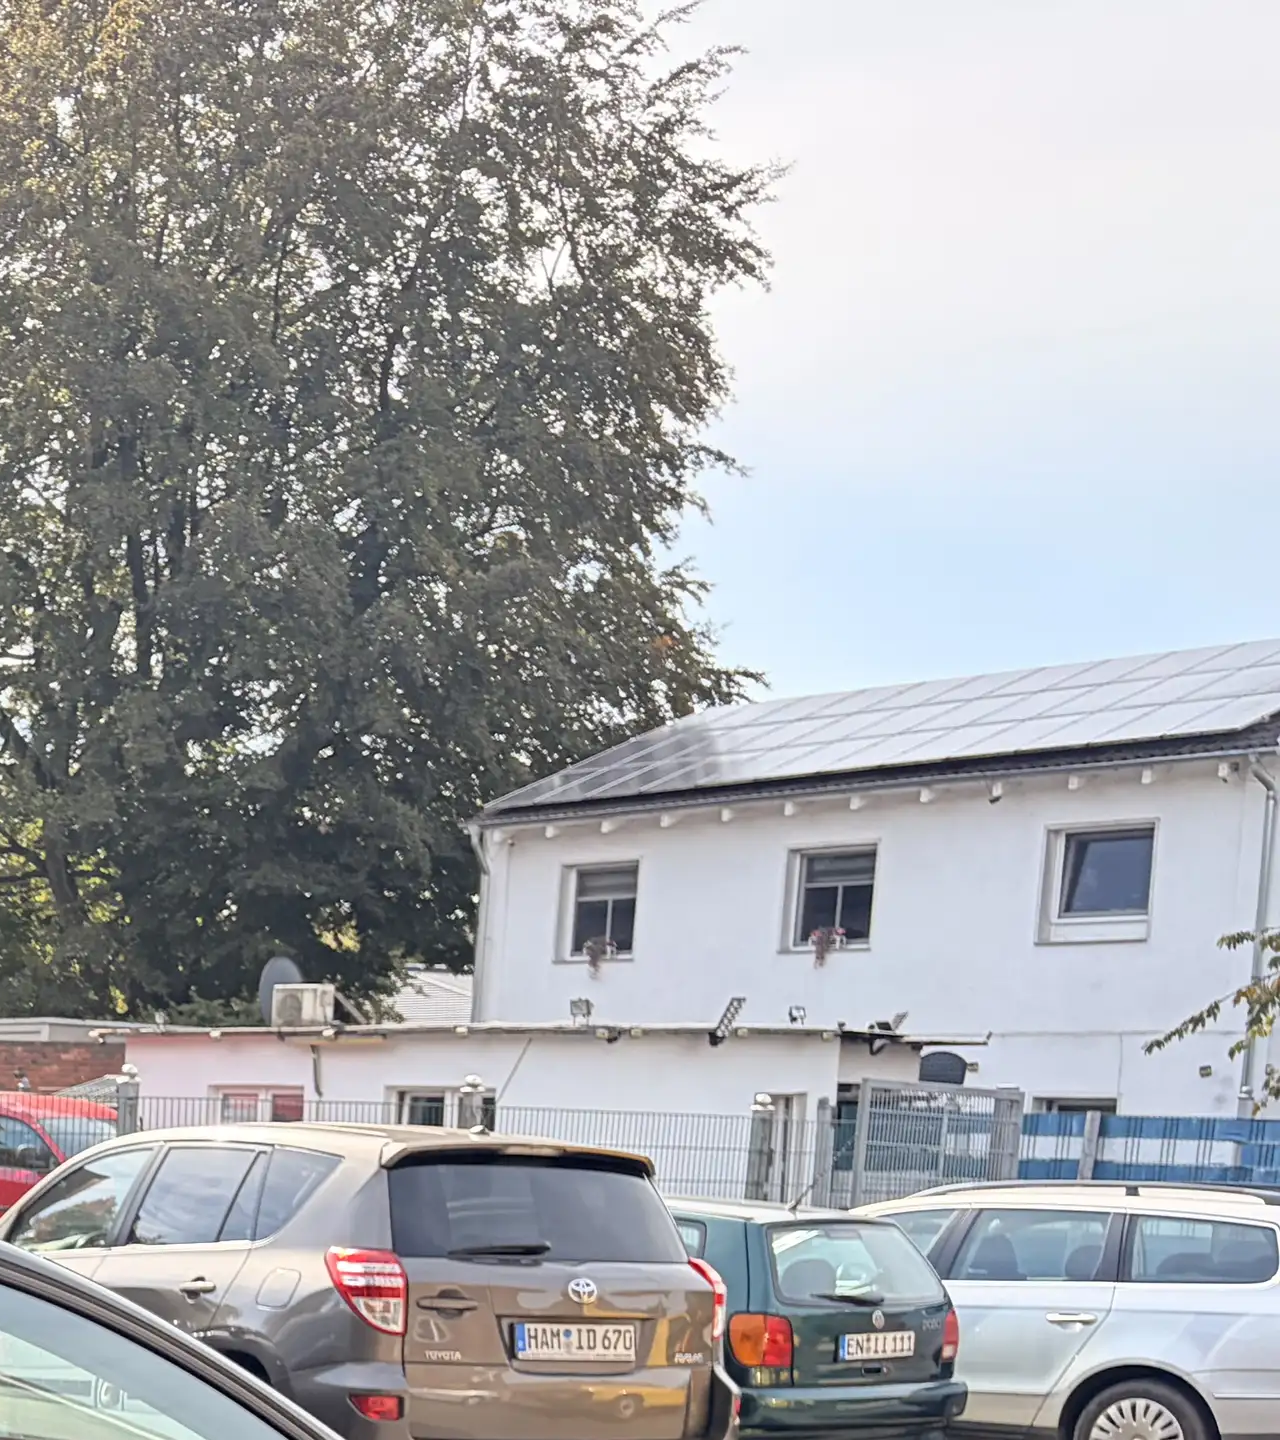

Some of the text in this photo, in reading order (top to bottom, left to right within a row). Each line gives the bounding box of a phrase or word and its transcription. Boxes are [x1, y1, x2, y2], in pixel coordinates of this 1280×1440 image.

[527, 1329, 633, 1351] HAM ID 670
[846, 1337, 865, 1356] EN
[891, 1334, 912, 1353] 111
[424, 1350, 462, 1361] TOYOTA
